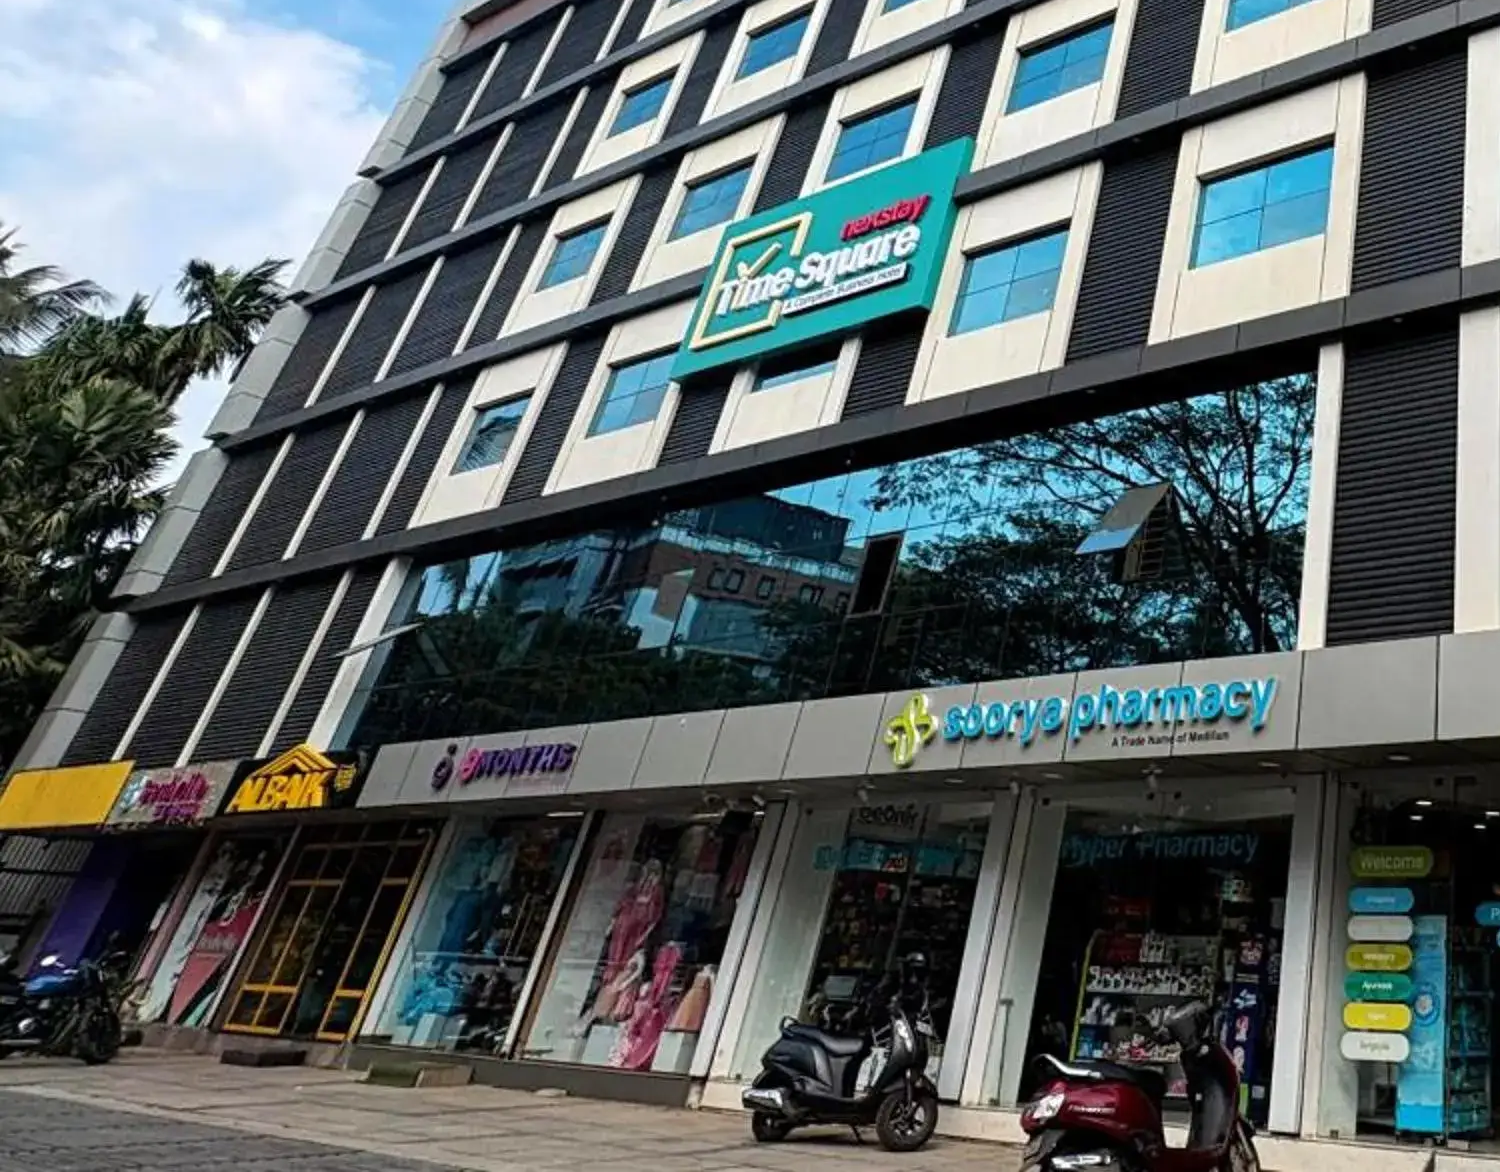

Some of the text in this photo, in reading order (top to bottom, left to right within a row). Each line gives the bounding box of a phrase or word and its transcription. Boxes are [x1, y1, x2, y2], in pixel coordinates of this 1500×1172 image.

[716, 225, 920, 315] Time Square
[942, 677, 1276, 746] soorya pharmacy
[1111, 736, 1118, 747] A
[1121, 735, 1145, 747] Trade
[1361, 851, 1424, 869] Welcome
